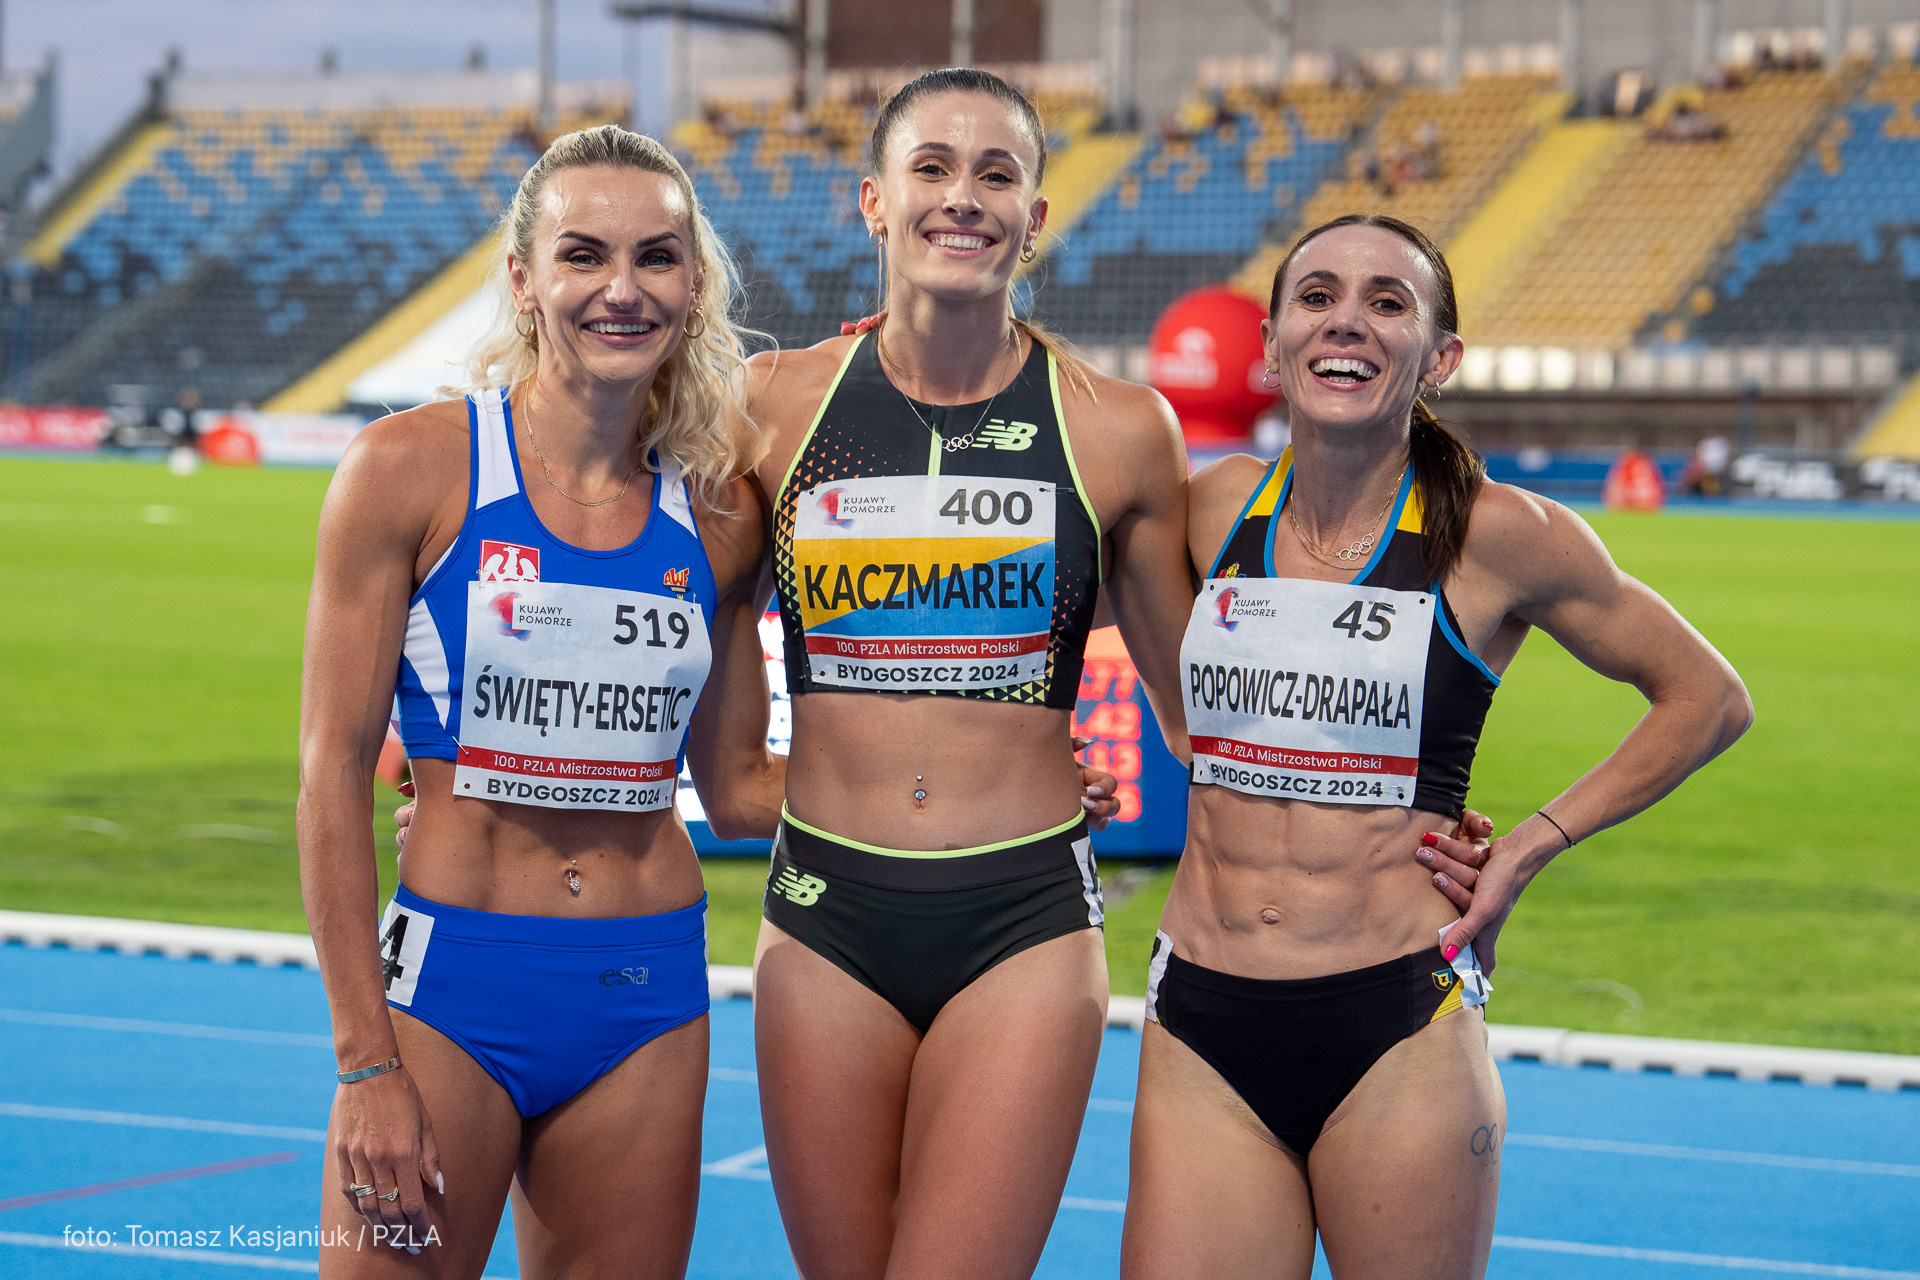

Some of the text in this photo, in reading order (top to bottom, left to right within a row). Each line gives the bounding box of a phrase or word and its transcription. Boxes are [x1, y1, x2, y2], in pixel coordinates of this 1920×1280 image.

[843, 505, 896, 513] POMORZE
[844, 496, 886, 504] KUJAWY
[939, 488, 1033, 526] 400
[804, 562, 1046, 611] KACZMAREK
[519, 604, 563, 615] KUJAWY
[1231, 607, 1277, 618] POMORZE
[1234, 599, 1271, 608] KUJAWY
[519, 615, 572, 627] POMORZE
[613, 604, 690, 650] 519
[1332, 600, 1396, 642] 45
[836, 640, 1020, 656] 100. PZLA Mistrzostwa Polski
[837, 663, 1019, 683] BYDGOSZCZ 2024
[473, 664, 692, 737] ŚWIĘTY-ERSETIC
[1190, 663, 1411, 729] POPOWICZ-DRAPAŁA
[494, 754, 663, 778] 100. PZLA Mistrzostwa Polski
[1217, 740, 1382, 770] 100. PZLA Mistrzostwa Polski
[487, 778, 660, 806] BYDGOSZCZ 2024
[1210, 763, 1383, 798] BYDGOSZCZ 2024
